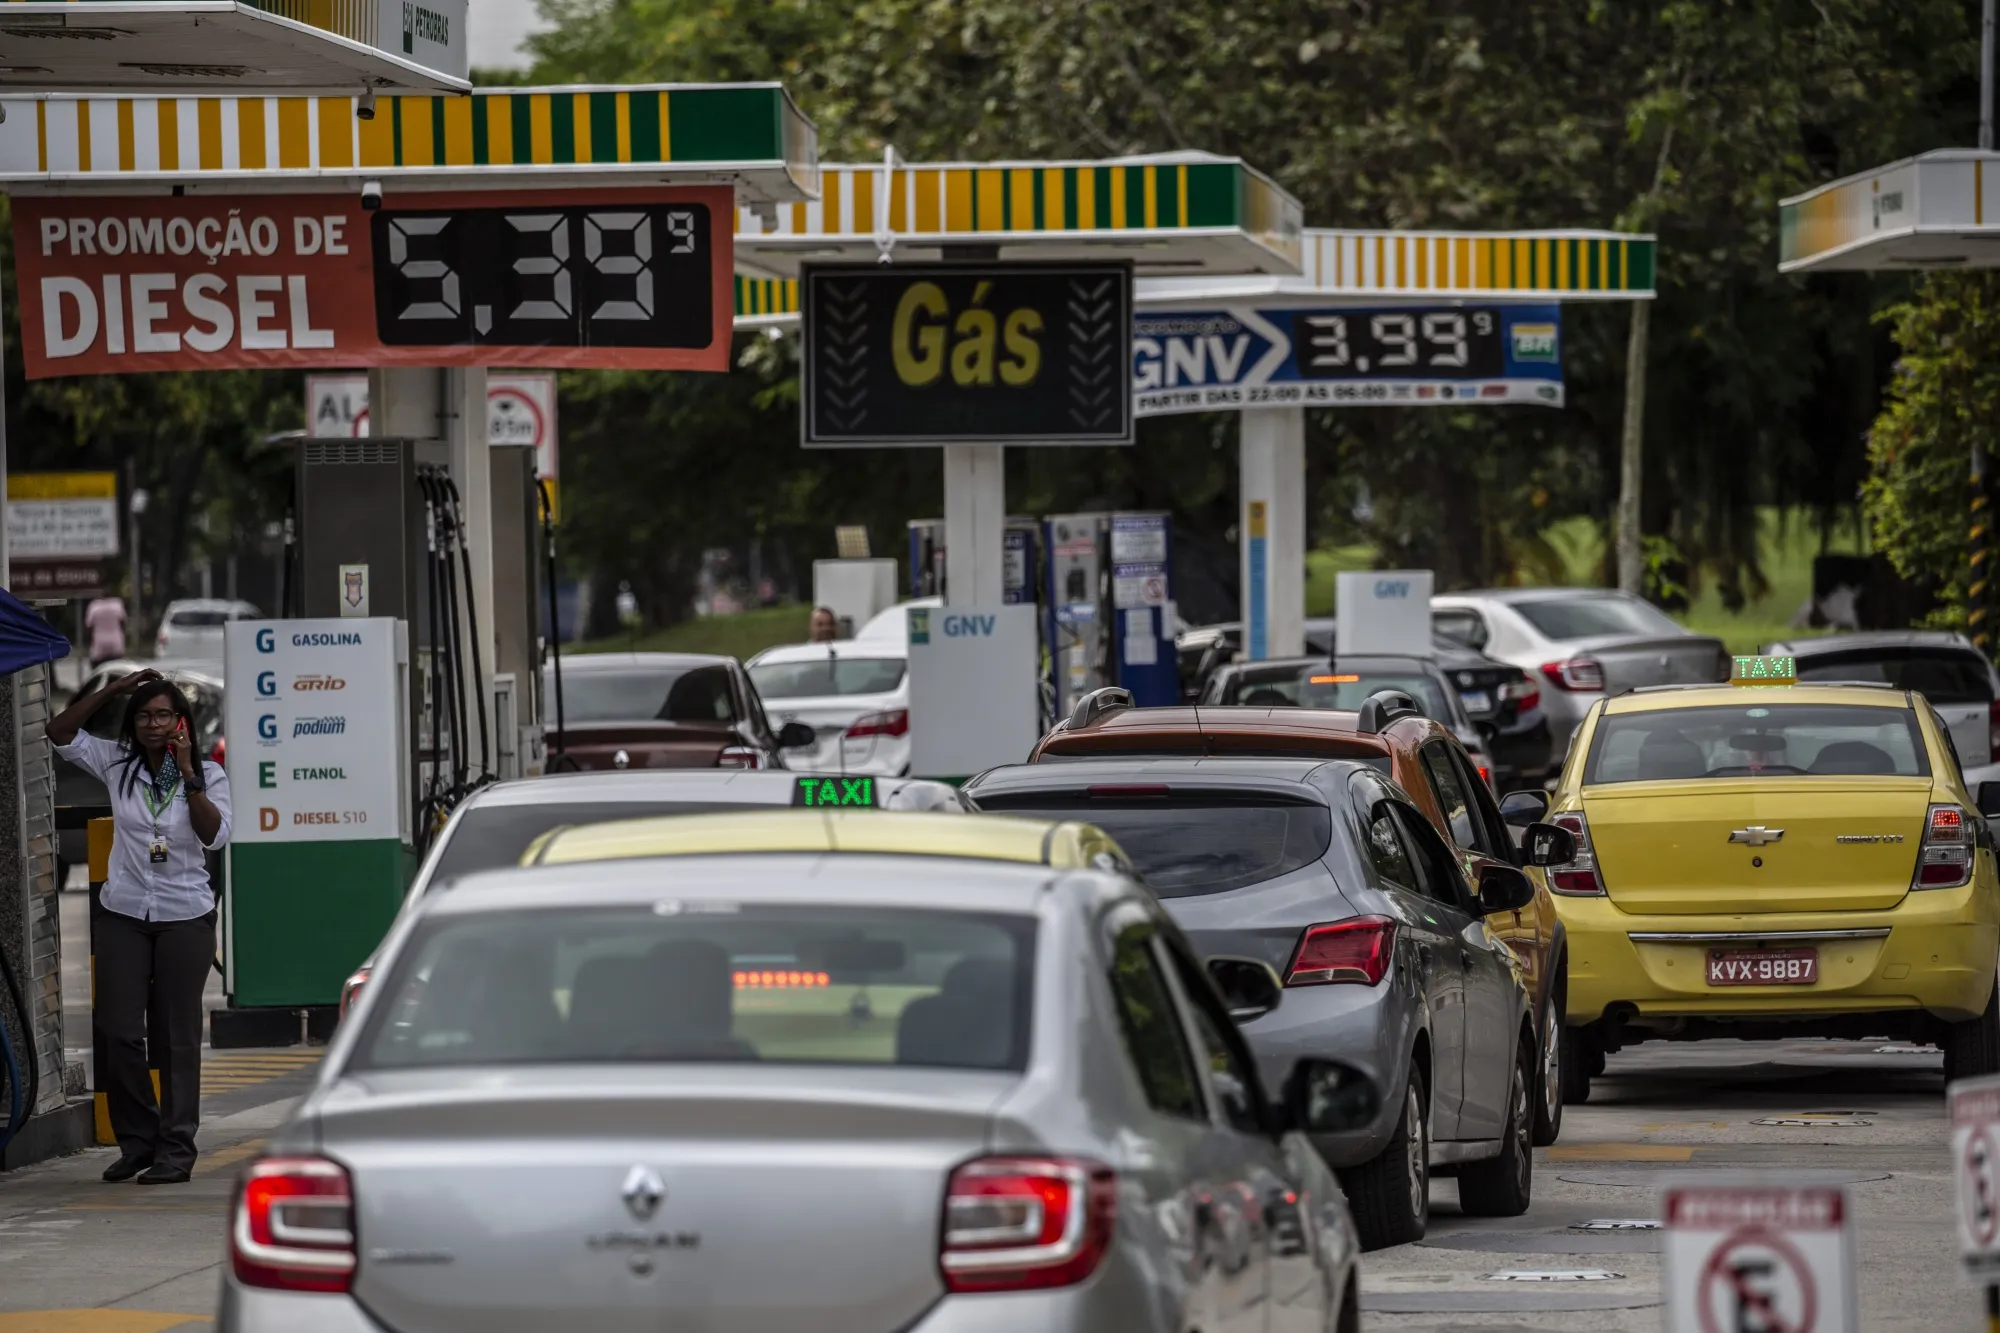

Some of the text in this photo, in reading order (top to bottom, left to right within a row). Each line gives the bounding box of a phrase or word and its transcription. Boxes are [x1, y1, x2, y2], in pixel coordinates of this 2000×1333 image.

[415, 6, 449, 47] PETROBRAS
[40, 208, 349, 265] PROMOÇÃO DE
[40, 272, 335, 359] DIESEL
[892, 280, 1044, 386] Gás
[1132, 334, 1251, 390] GNV
[1138, 391, 1201, 411] PARTIR
[1205, 389, 1242, 404] DAS
[943, 613, 997, 638] GNV
[255, 628, 362, 654] G GASOLINA
[1736, 657, 1793, 678] TAXI
[257, 671, 276, 696] G
[258, 714, 345, 740] G podium
[259, 761, 347, 788] E ETANOL
[799, 778, 872, 805] TAXI
[260, 807, 367, 832] D DIESEL S10
